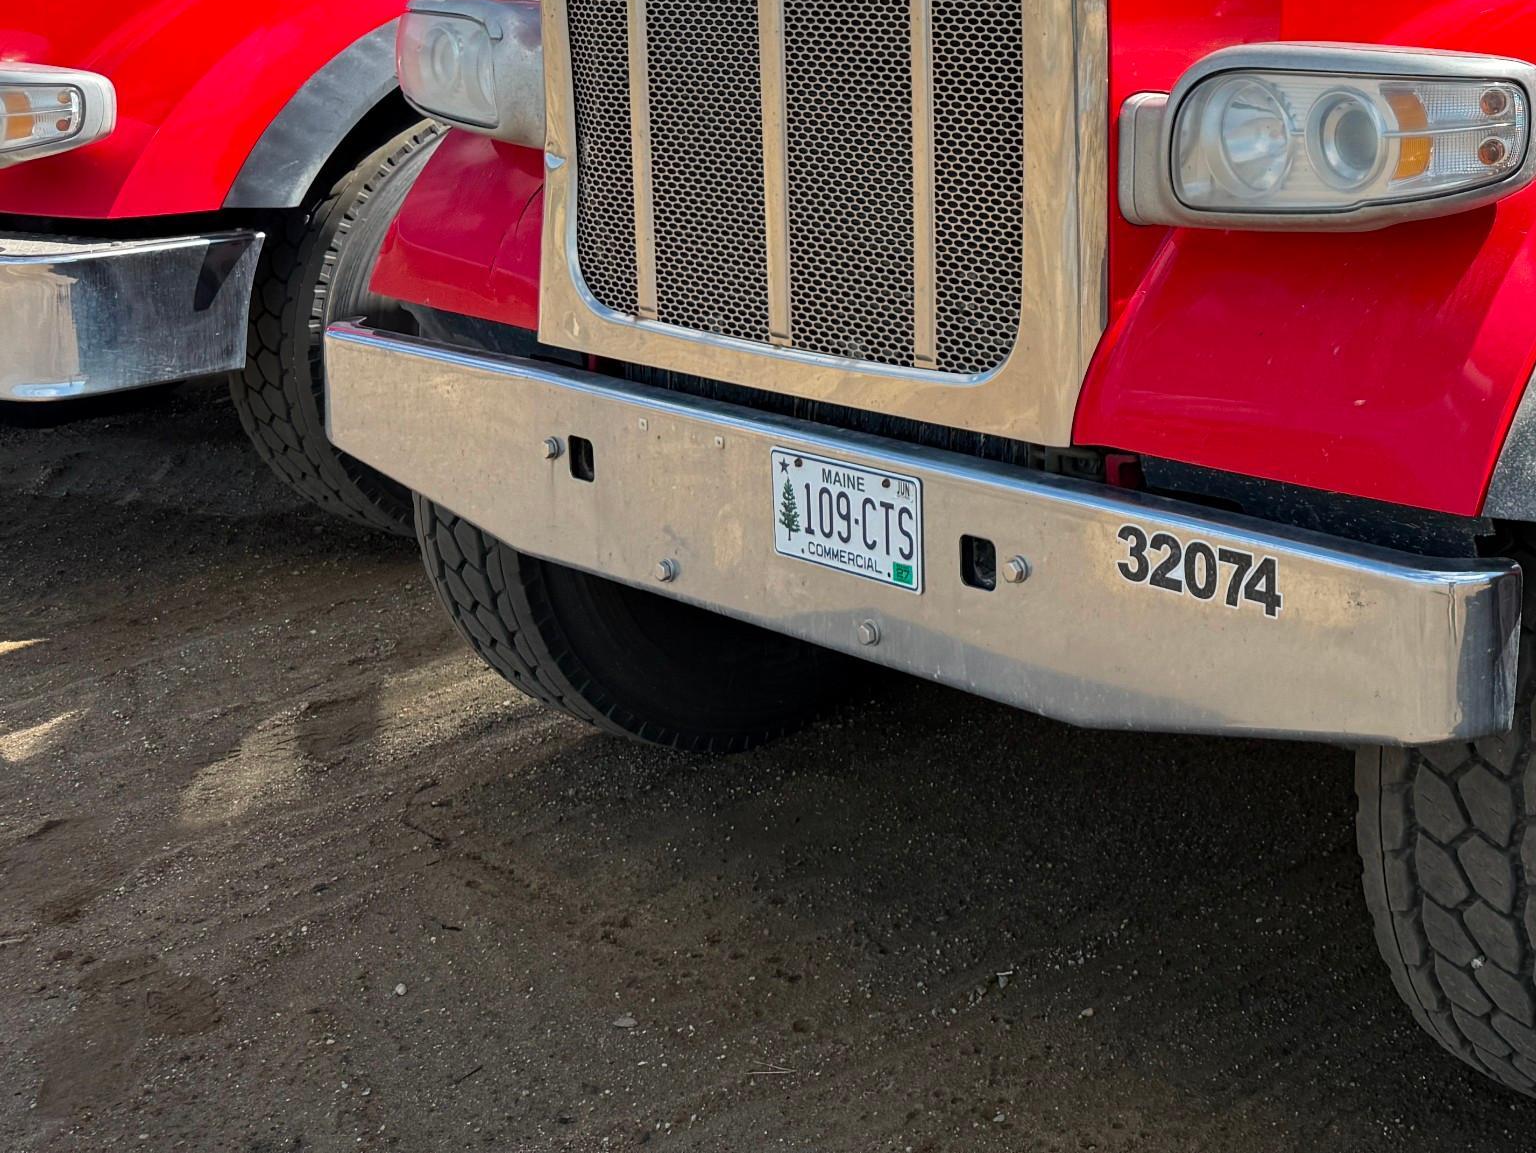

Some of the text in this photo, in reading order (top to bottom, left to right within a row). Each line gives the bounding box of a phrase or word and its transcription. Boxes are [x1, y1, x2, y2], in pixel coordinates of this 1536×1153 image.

[821, 467, 911, 497] MAINE JUN
[807, 540, 883, 575] COMMERCIAL
[1117, 524, 1282, 618] 32074
